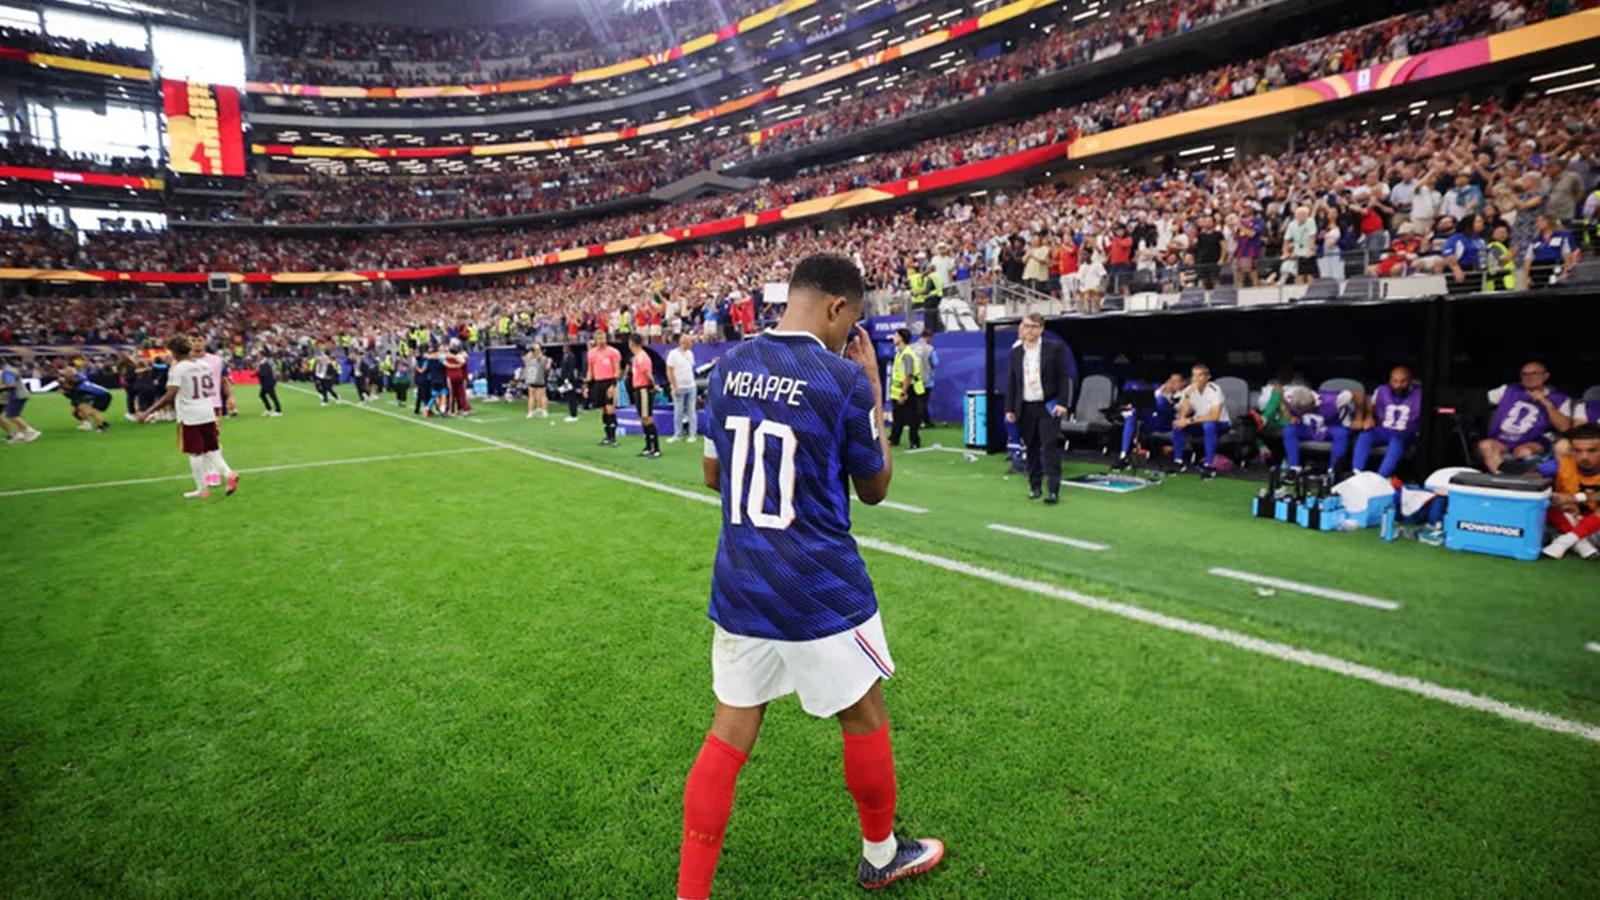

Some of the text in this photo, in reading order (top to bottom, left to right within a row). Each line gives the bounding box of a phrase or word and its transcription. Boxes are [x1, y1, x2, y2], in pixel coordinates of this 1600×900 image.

[191, 375, 214, 399] 19
[723, 371, 807, 406] MBAPPE
[725, 415, 798, 530] 10
[1459, 521, 1520, 537] POWERADE
